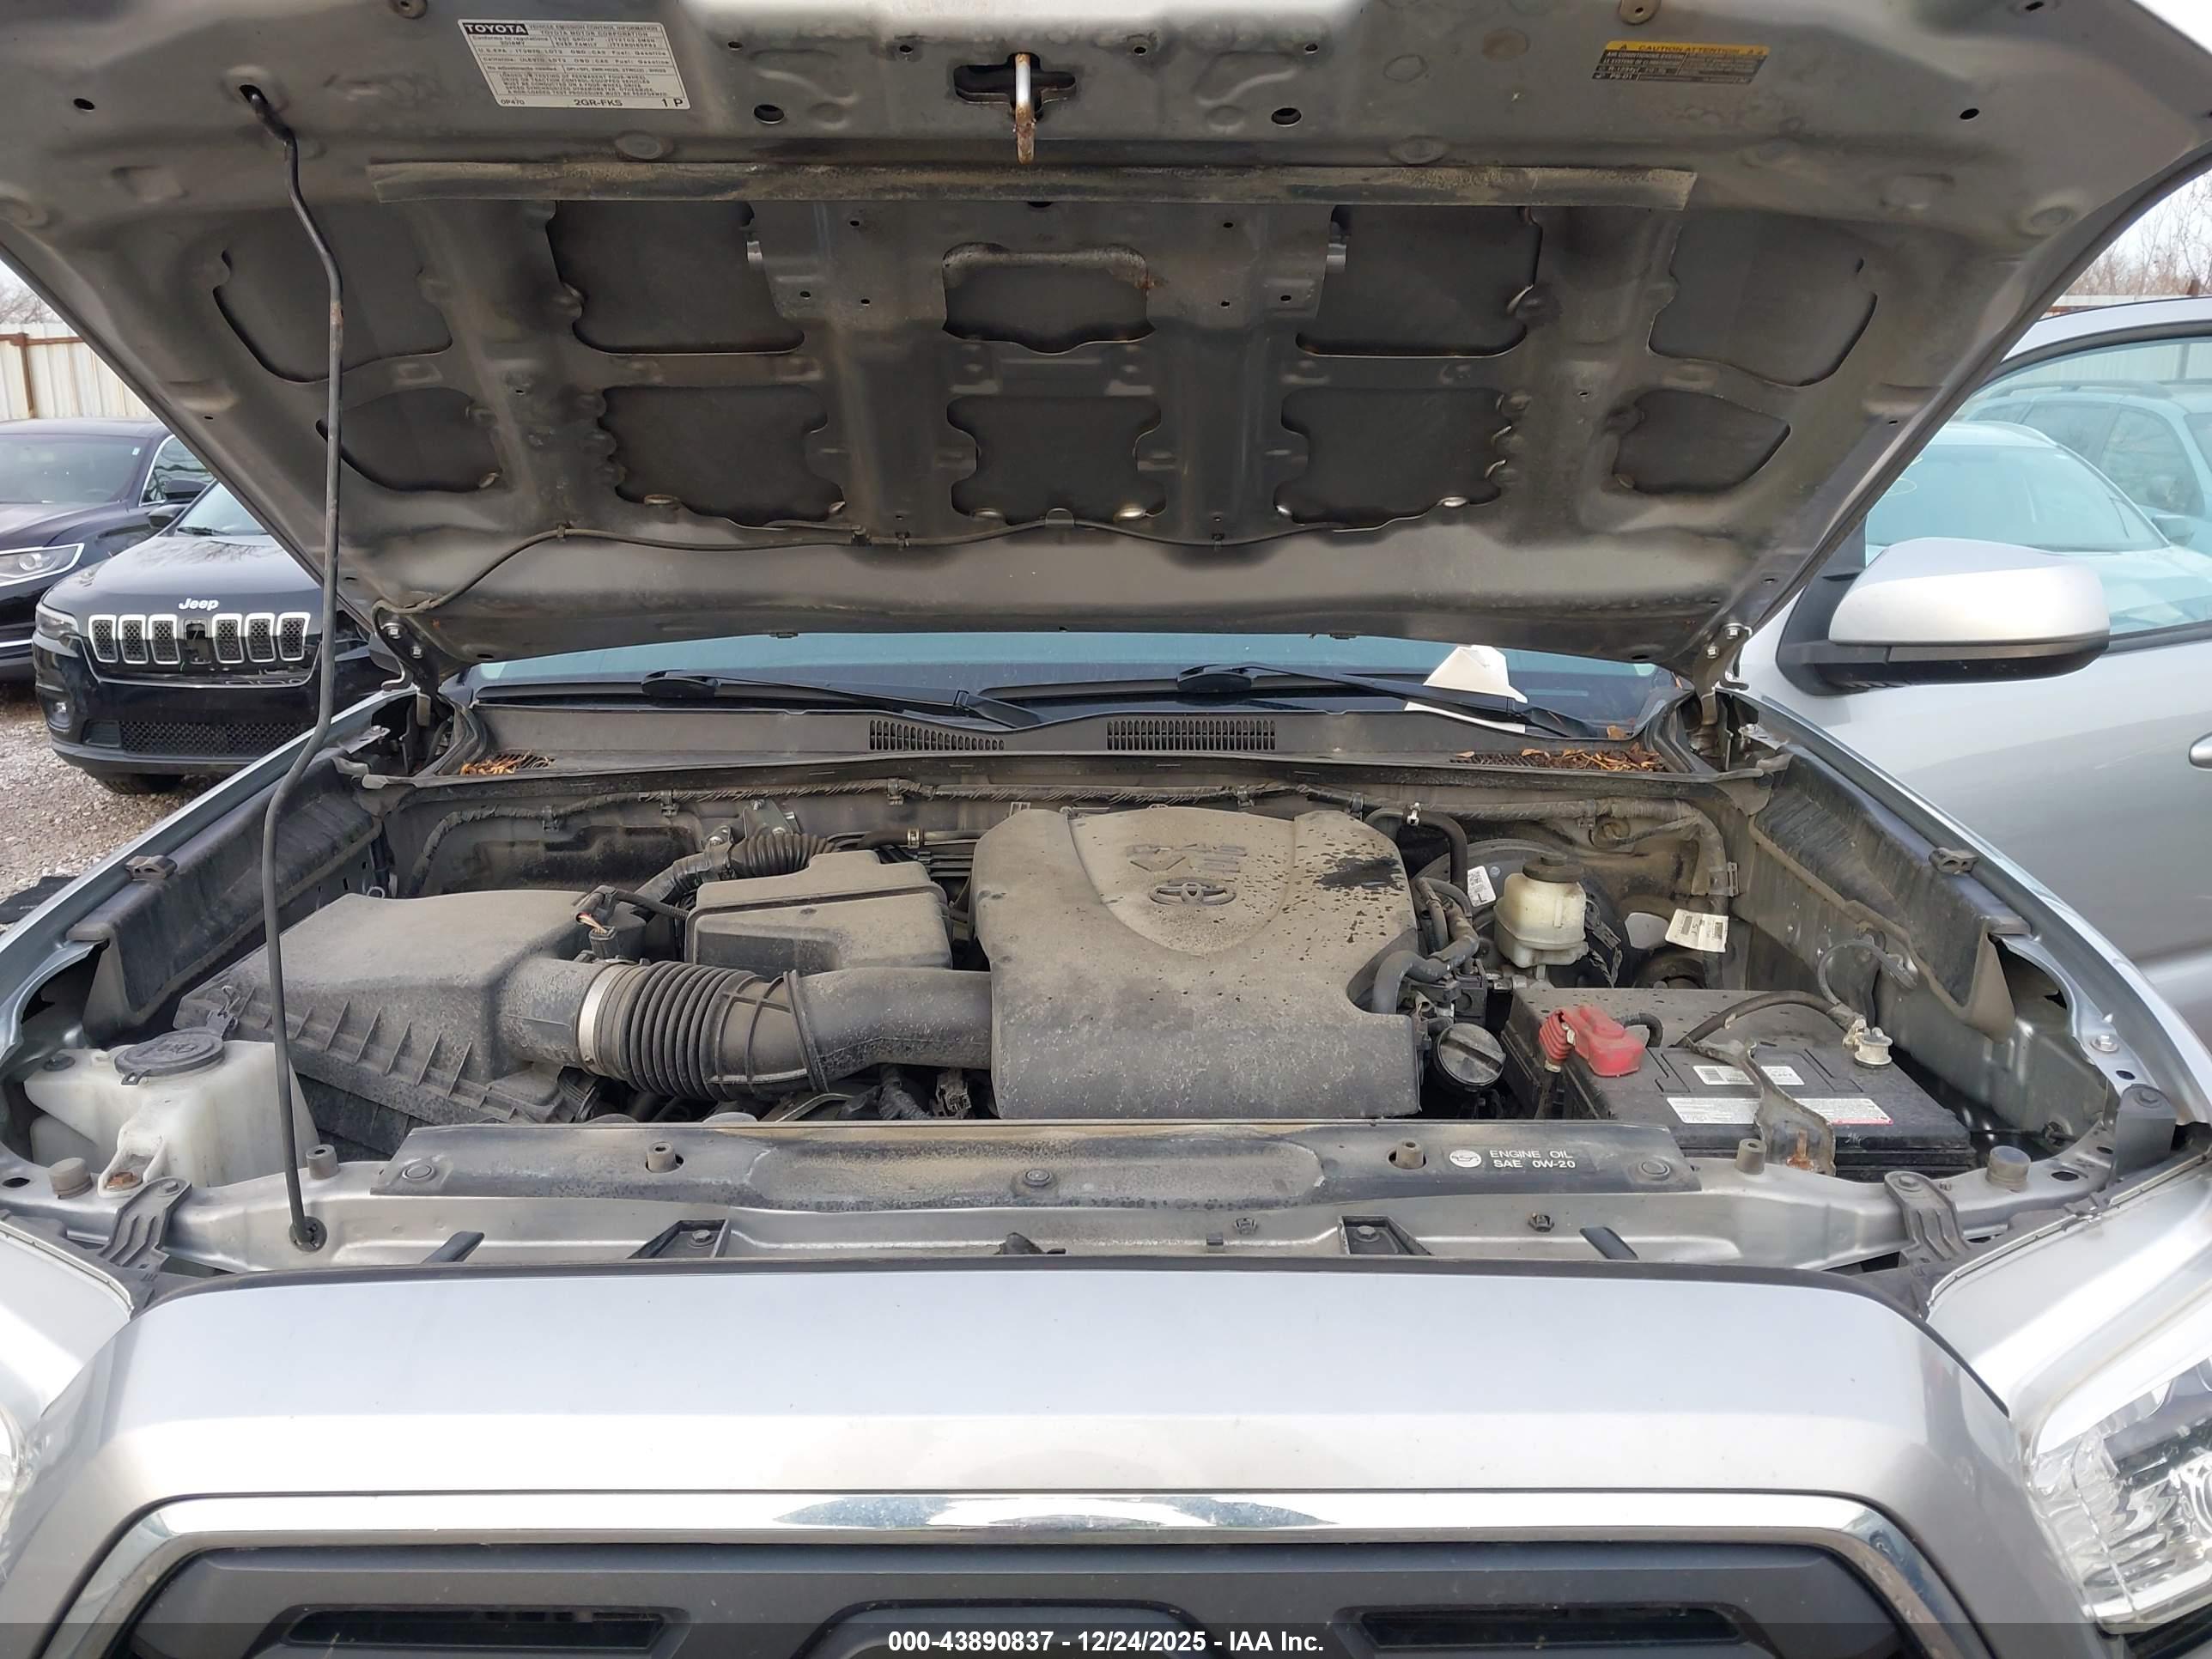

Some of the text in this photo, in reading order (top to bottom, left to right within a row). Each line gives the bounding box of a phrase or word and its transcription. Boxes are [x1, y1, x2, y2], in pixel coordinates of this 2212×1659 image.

[465, 24, 526, 34] TOYOTA
[179, 599, 219, 611] Jeep
[1490, 1150, 1541, 1158] ENGINE
[1494, 1159, 1576, 1169] SAE 0W-20
